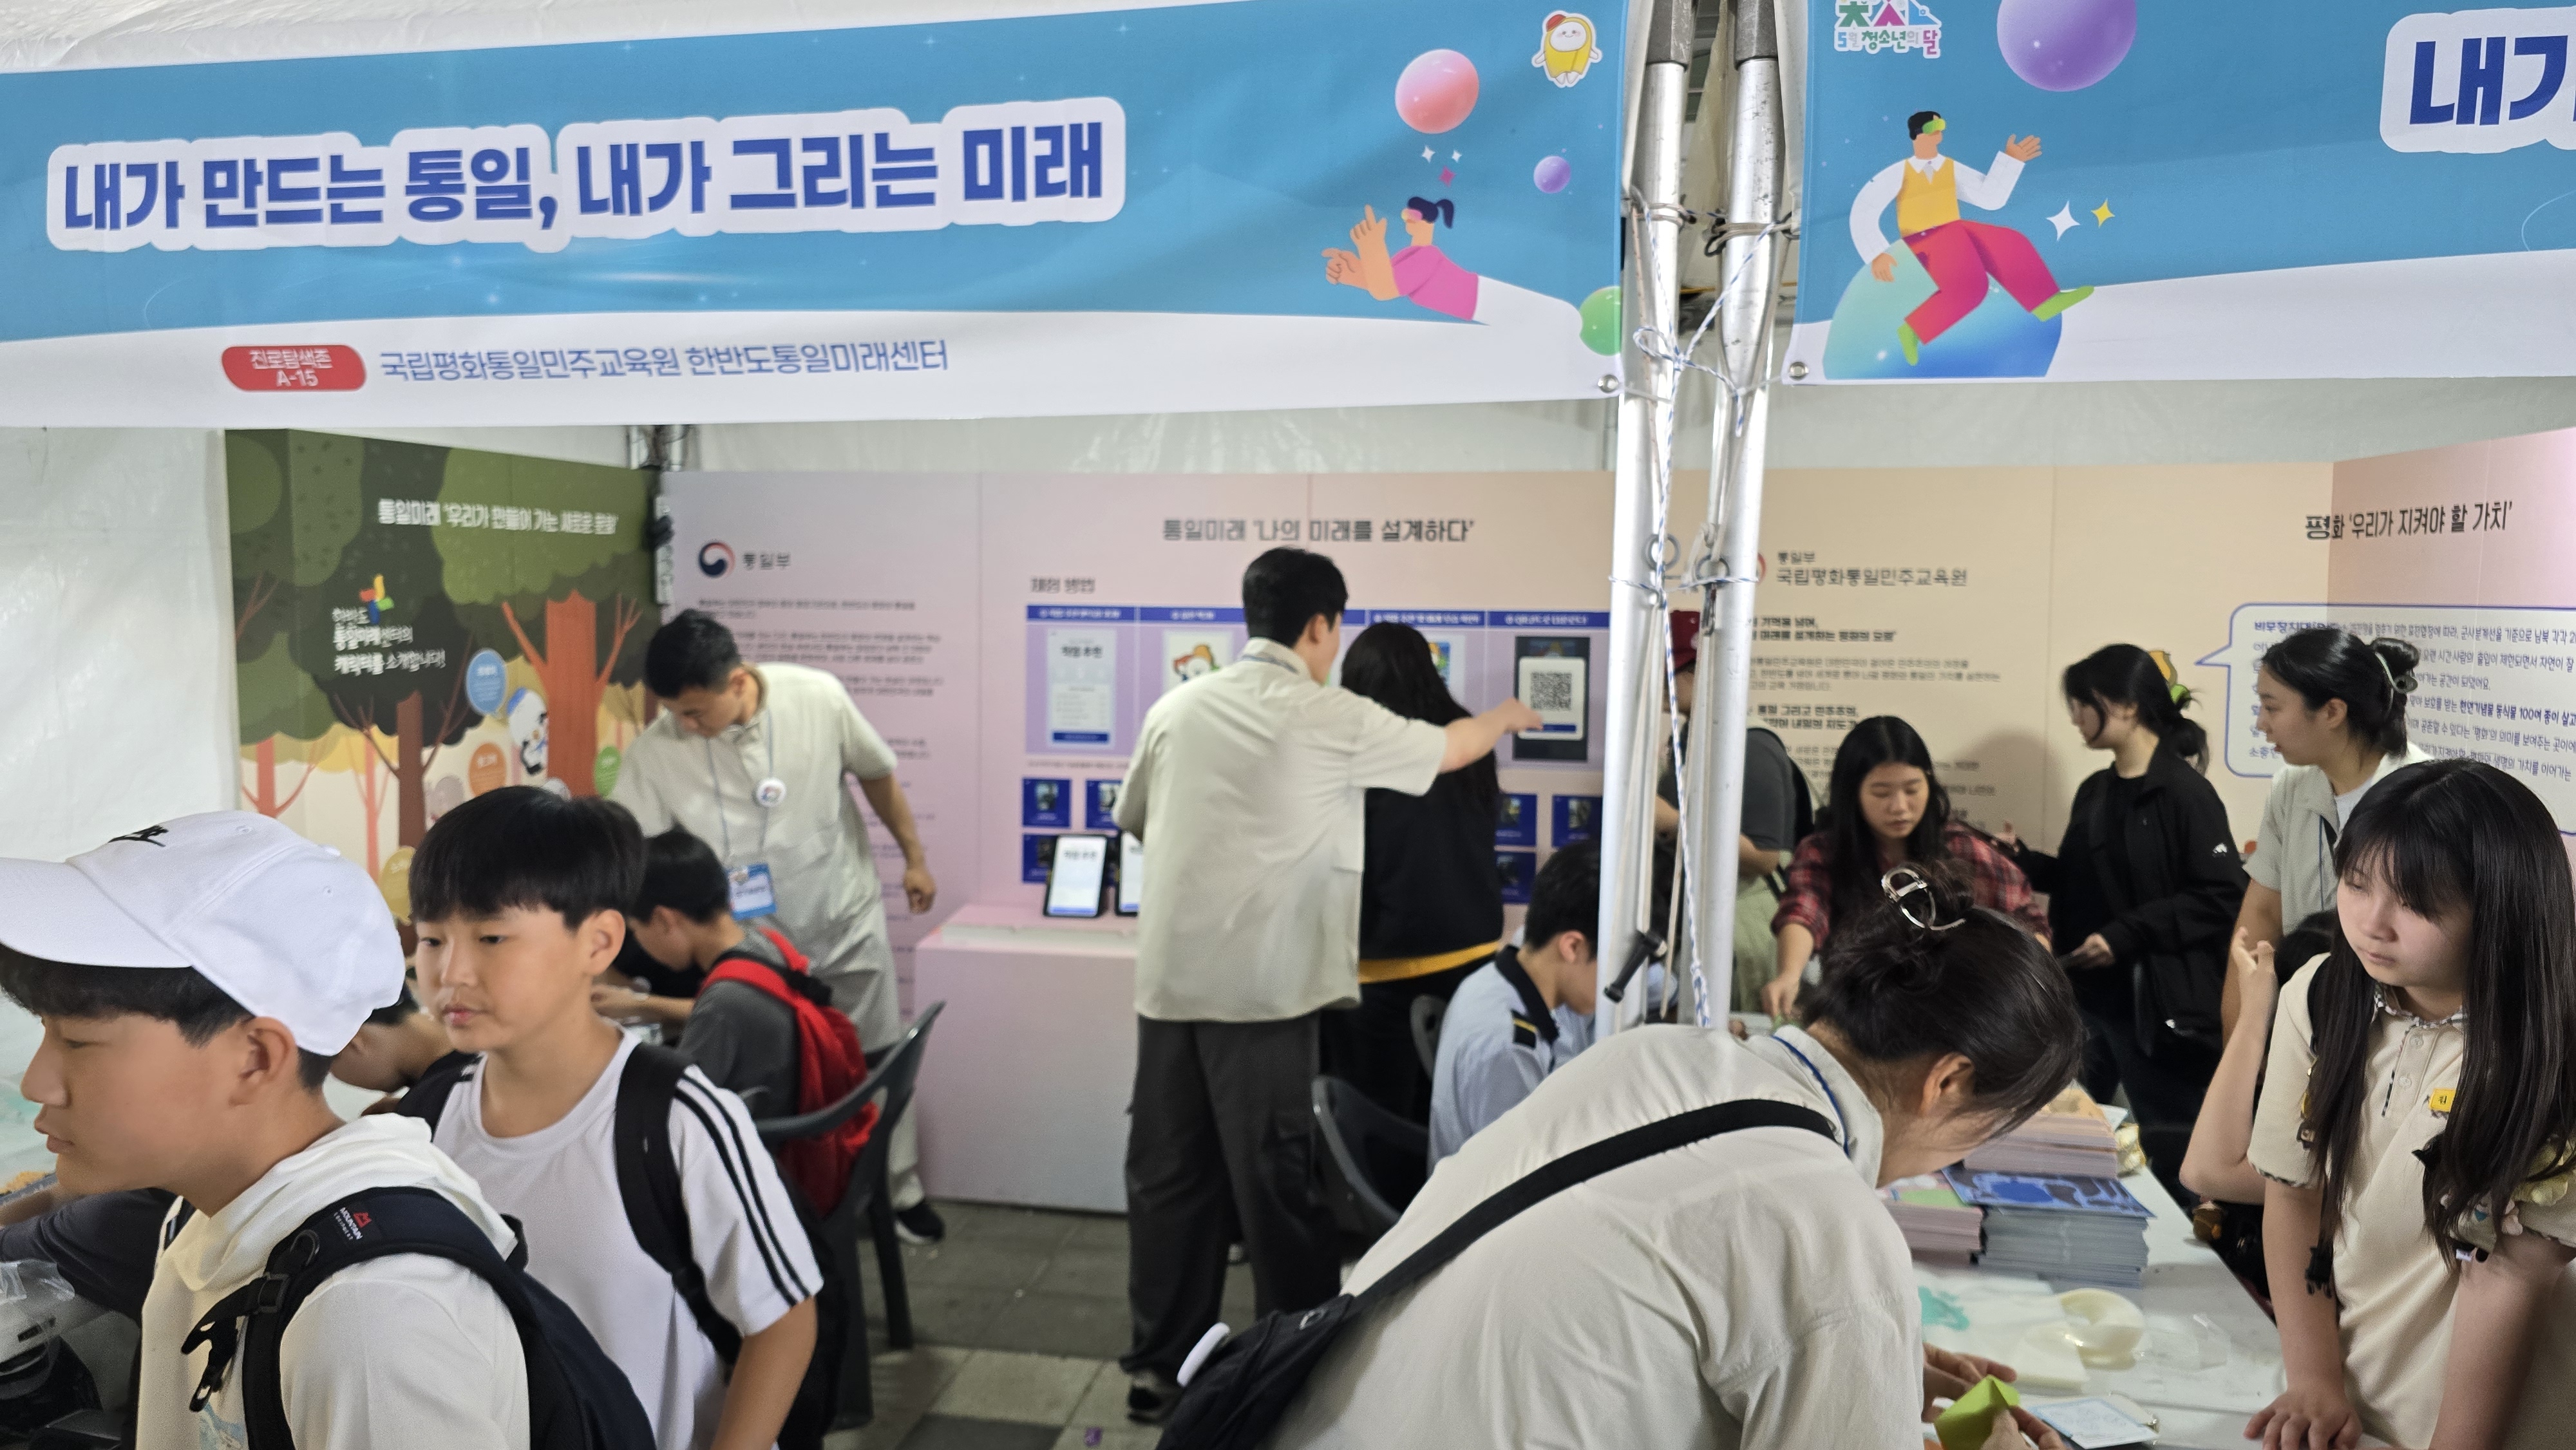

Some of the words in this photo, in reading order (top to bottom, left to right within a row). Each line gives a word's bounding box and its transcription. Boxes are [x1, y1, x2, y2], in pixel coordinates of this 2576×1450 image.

[1861, 29, 1919, 51] 청소년의
[1923, 29, 1938, 55] 달
[64, 160, 187, 231] 내가
[201, 153, 387, 229] 만드는
[404, 146, 559, 231] 통일,
[577, 139, 713, 217] 내가
[728, 131, 940, 211] 그리는
[961, 121, 1104, 203] 미래
[249, 348, 334, 370] 진로탐색존
[380, 346, 682, 382] 국립평화통일민주교육원
[685, 339, 949, 377] 한반도통일미래센터
[276, 369, 319, 388] A-15
[378, 498, 441, 526] 통일미래
[2305, 513, 2345, 541] 평화
[2398, 505, 2446, 536] 지켜야
[2450, 503, 2468, 534] 할
[1163, 518, 1247, 542] 통일미래
[1308, 518, 1373, 542] 미래를
[1776, 566, 1969, 587] 국립평화통일민주교육원
[2504, 626, 2532, 643] 기준으로
[2534, 628, 2550, 645] 남북
[2551, 628, 2568, 646] 각각
[2477, 650, 2498, 666] 출입이
[2539, 655, 2564, 672] 자연이
[2566, 656, 2575, 673] 잘
[2424, 695, 2443, 711] 보호를
[2459, 699, 2494, 718] 천연기념물
[2496, 703, 2517, 720] 동식물
[2519, 706, 2542, 722] 100여
[2544, 709, 2559, 726] 종이
[2561, 710, 2576, 727] 살고
[2421, 719, 2440, 735] 공존할
[2441, 721, 2448, 735] 수
[2449, 722, 2470, 739] 있다는
[2499, 729, 2521, 747] 의미를
[2522, 732, 2551, 751] 보여주는
[2517, 758, 2539, 777] 가치를
[2541, 762, 2571, 782] 이어가는
